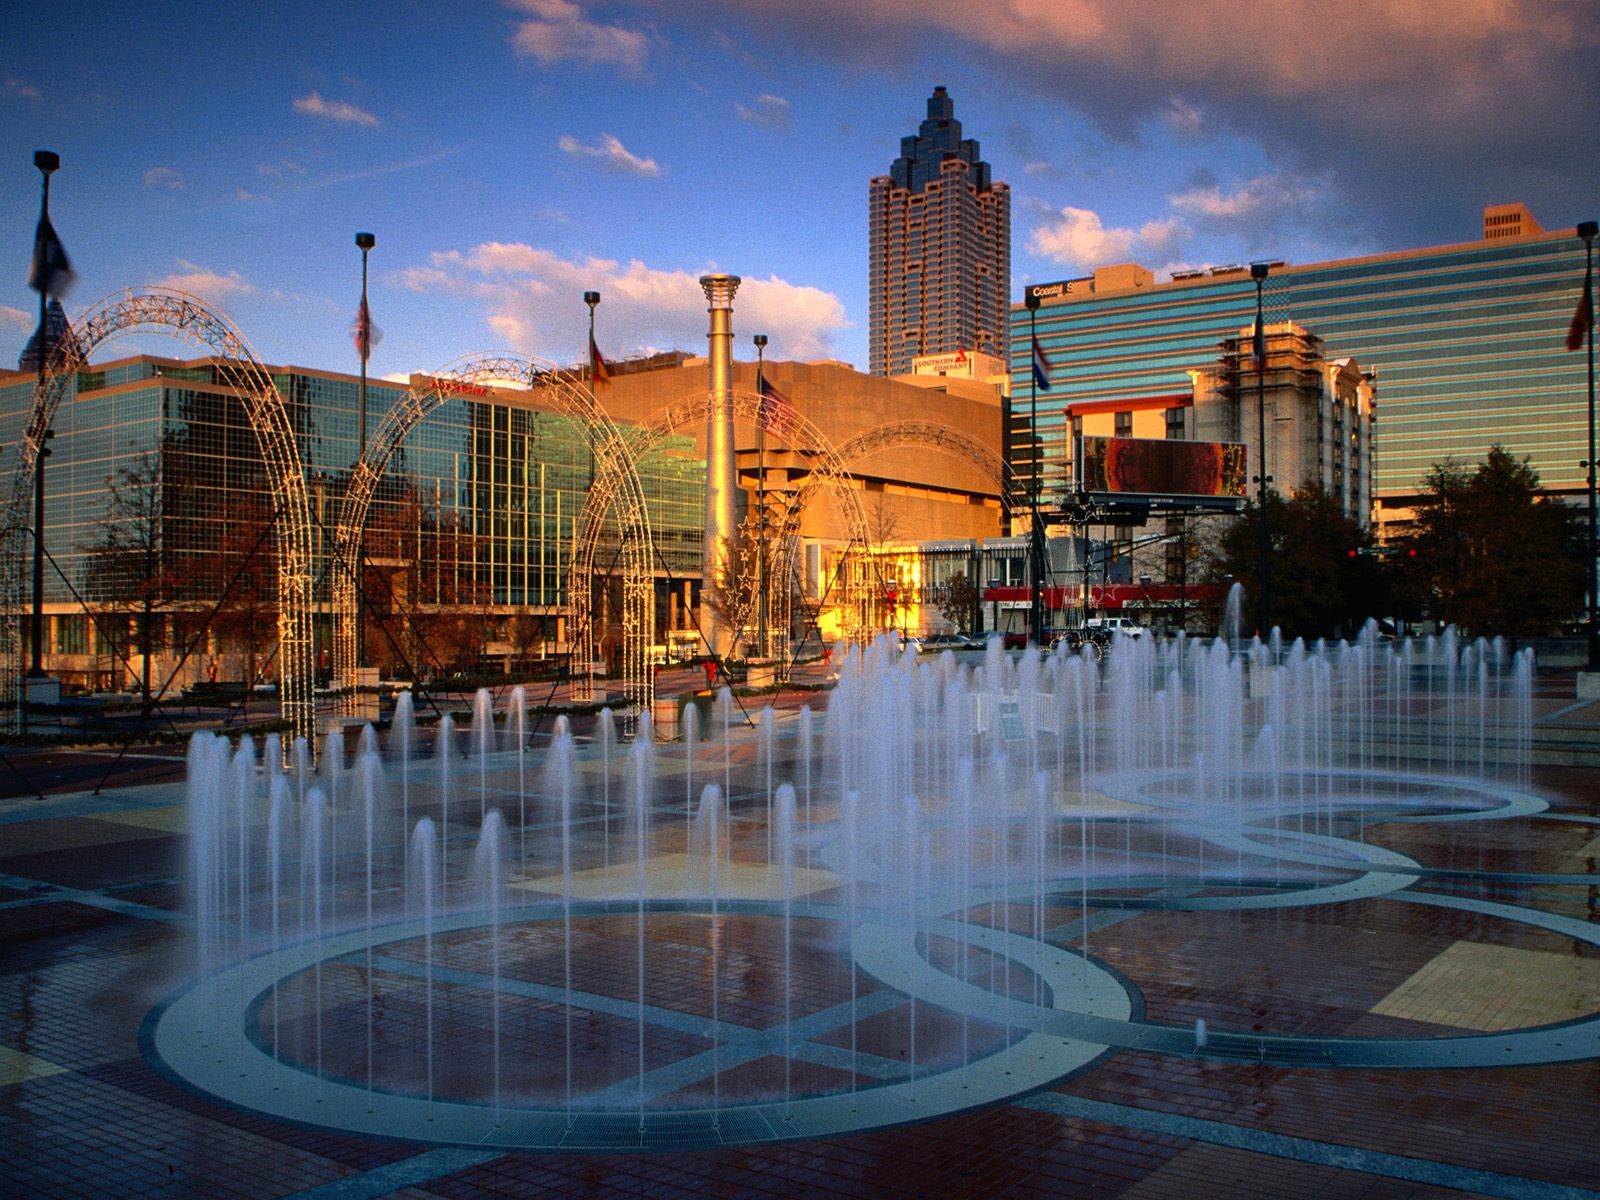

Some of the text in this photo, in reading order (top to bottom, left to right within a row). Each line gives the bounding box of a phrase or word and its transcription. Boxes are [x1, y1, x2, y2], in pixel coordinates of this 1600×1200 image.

[1033, 284, 1063, 297] Coastal
[918, 358, 954, 367] SOUTHERN
[934, 362, 968, 372] COMPANY
